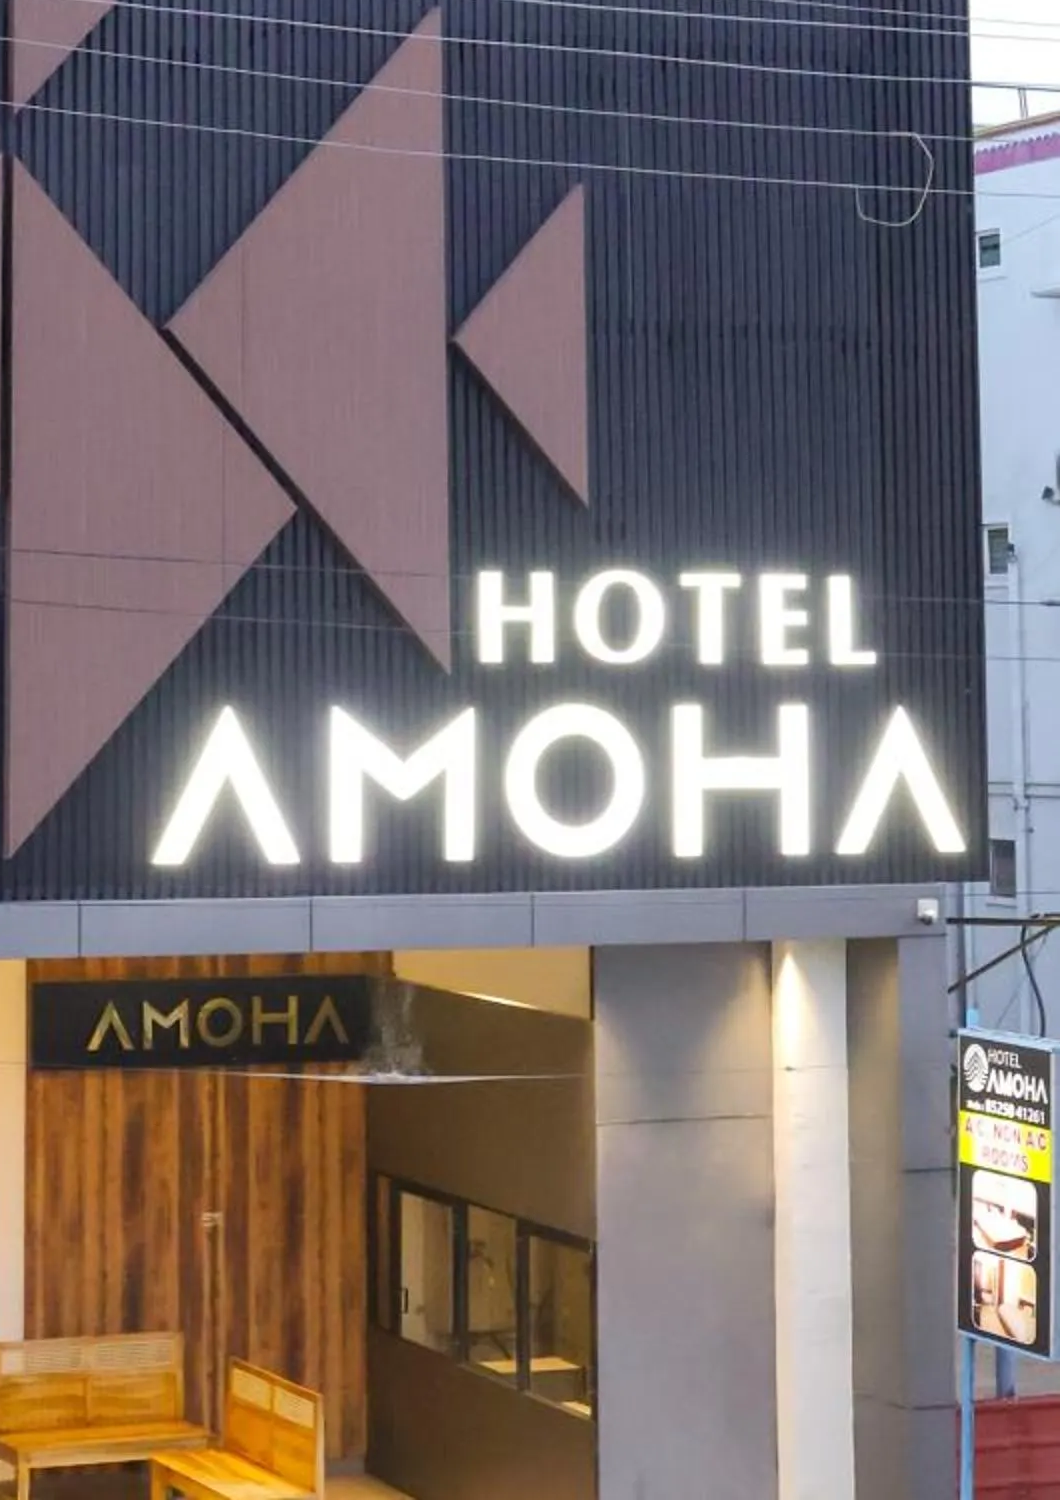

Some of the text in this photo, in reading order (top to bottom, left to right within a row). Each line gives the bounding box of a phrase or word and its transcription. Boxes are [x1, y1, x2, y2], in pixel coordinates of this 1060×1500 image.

[476, 568, 878, 667] HOTEL
[150, 703, 967, 867] AMOHA
[86, 994, 350, 1052] AMOHA
[986, 1069, 1049, 1104] AMOHA
[988, 1049, 1023, 1069] HOTEL
